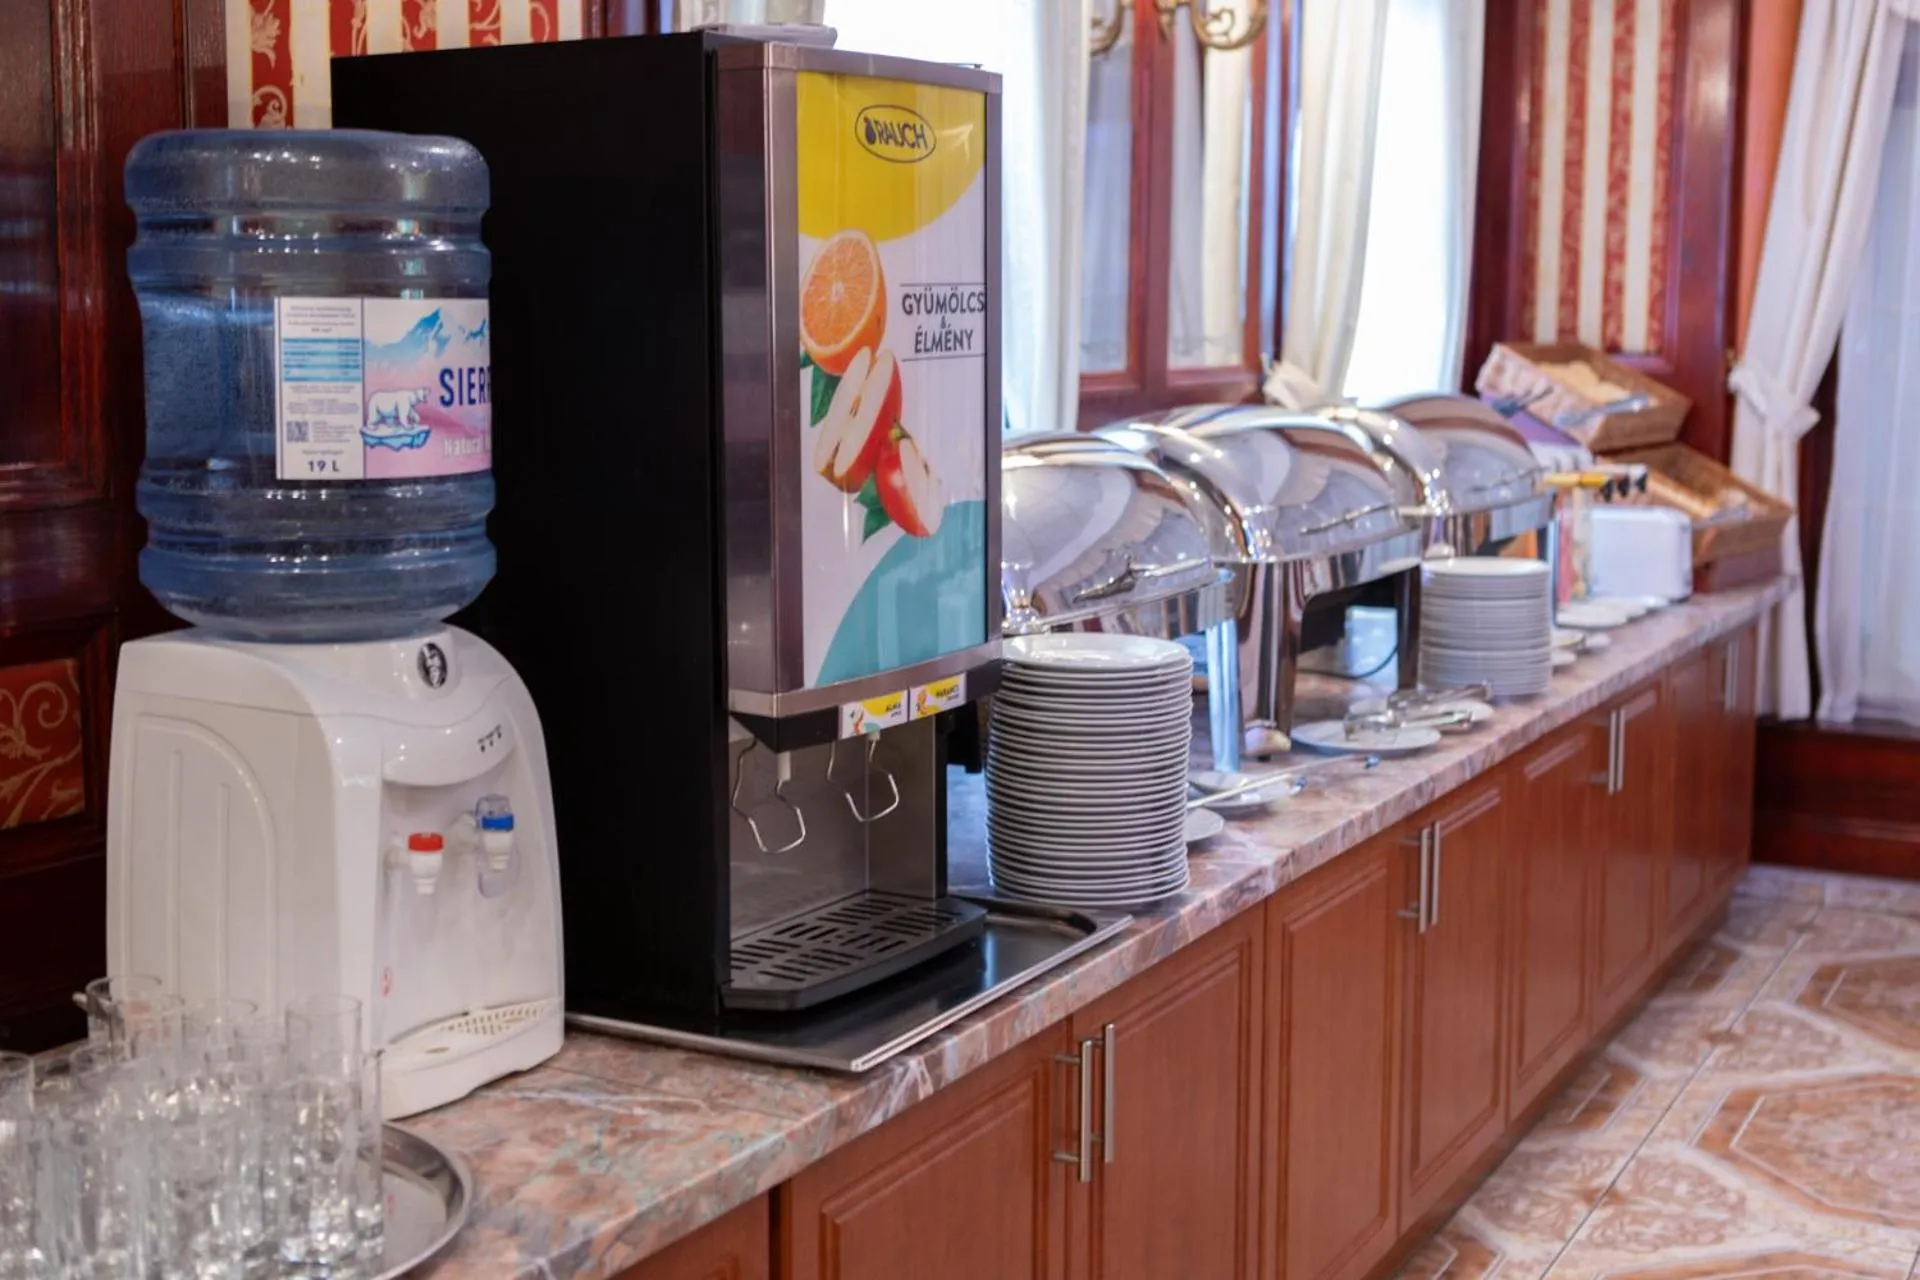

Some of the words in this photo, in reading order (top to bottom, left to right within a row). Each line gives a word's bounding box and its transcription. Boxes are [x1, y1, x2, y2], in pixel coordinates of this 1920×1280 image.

[874, 119, 928, 149] RAUCH
[902, 286, 985, 316] GYÜMÖLCS
[914, 324, 974, 354] ÉLMÉNY
[307, 460, 326, 473] 19
[332, 460, 340, 473] L
